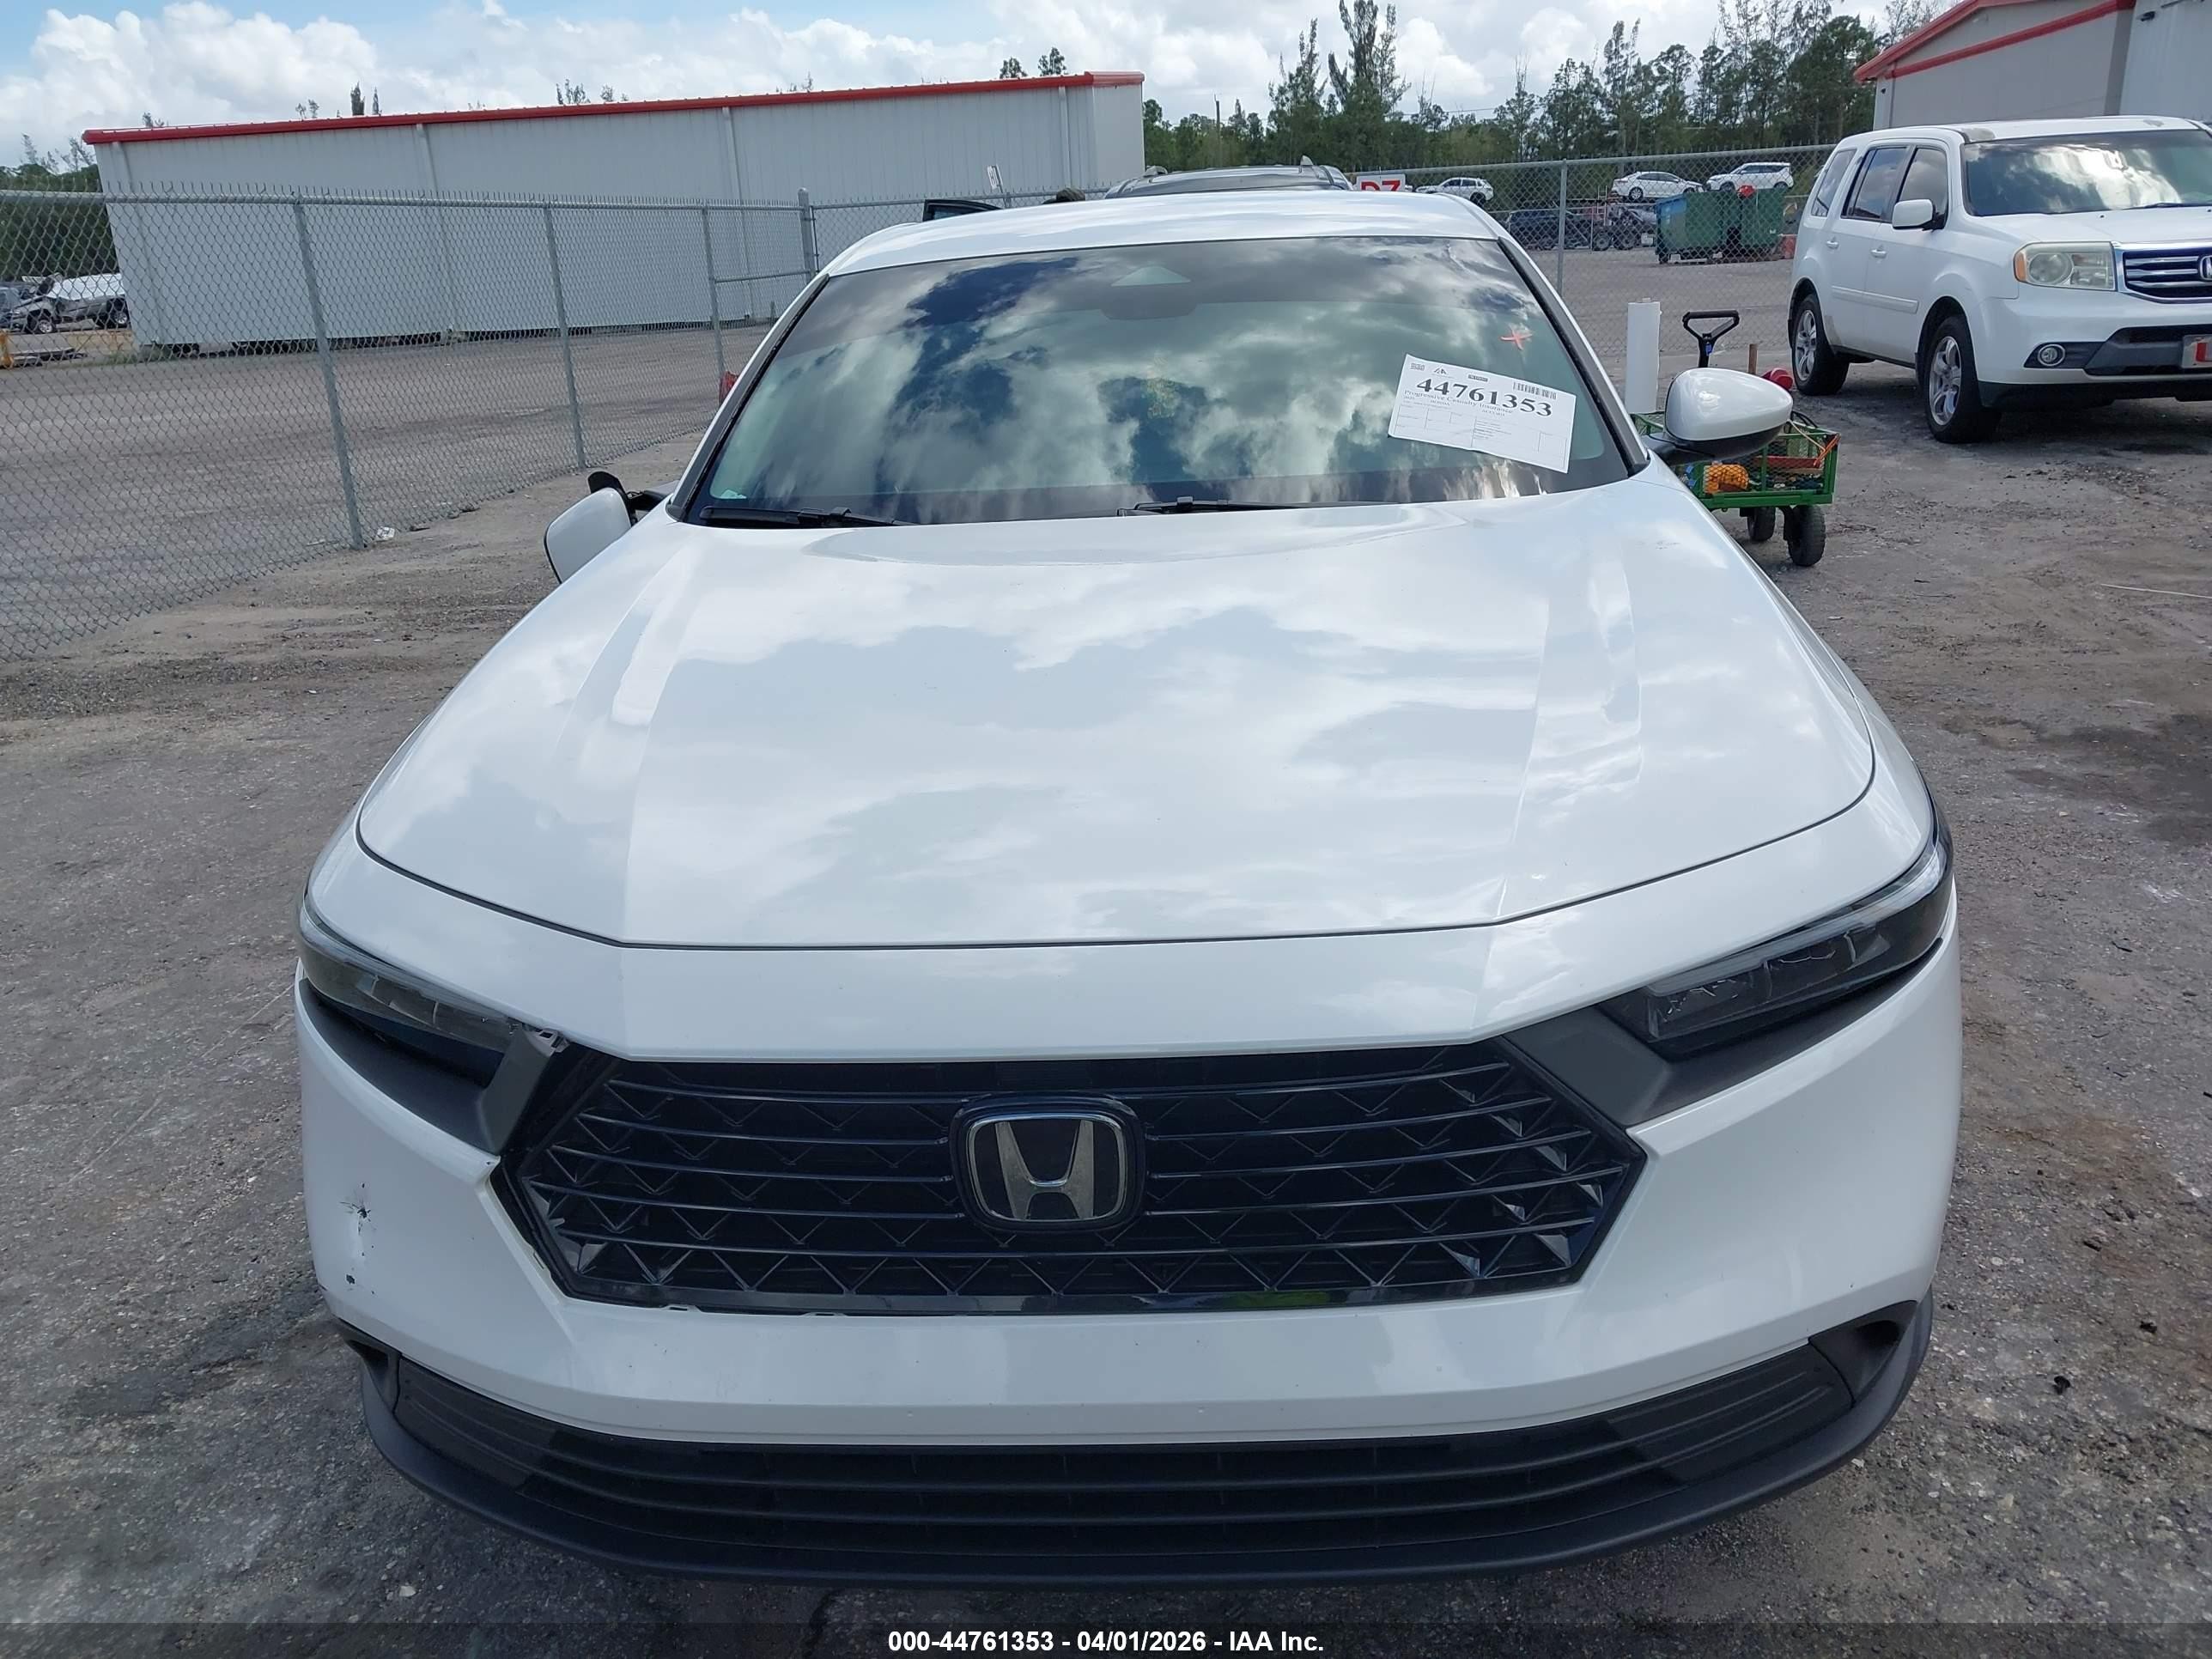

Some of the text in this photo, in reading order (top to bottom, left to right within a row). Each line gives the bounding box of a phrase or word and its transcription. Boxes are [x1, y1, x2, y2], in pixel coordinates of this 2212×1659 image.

[1404, 389, 1445, 402] Progressive
[1479, 403, 1513, 414] Insurance
[1416, 378, 1552, 416] 44761353
